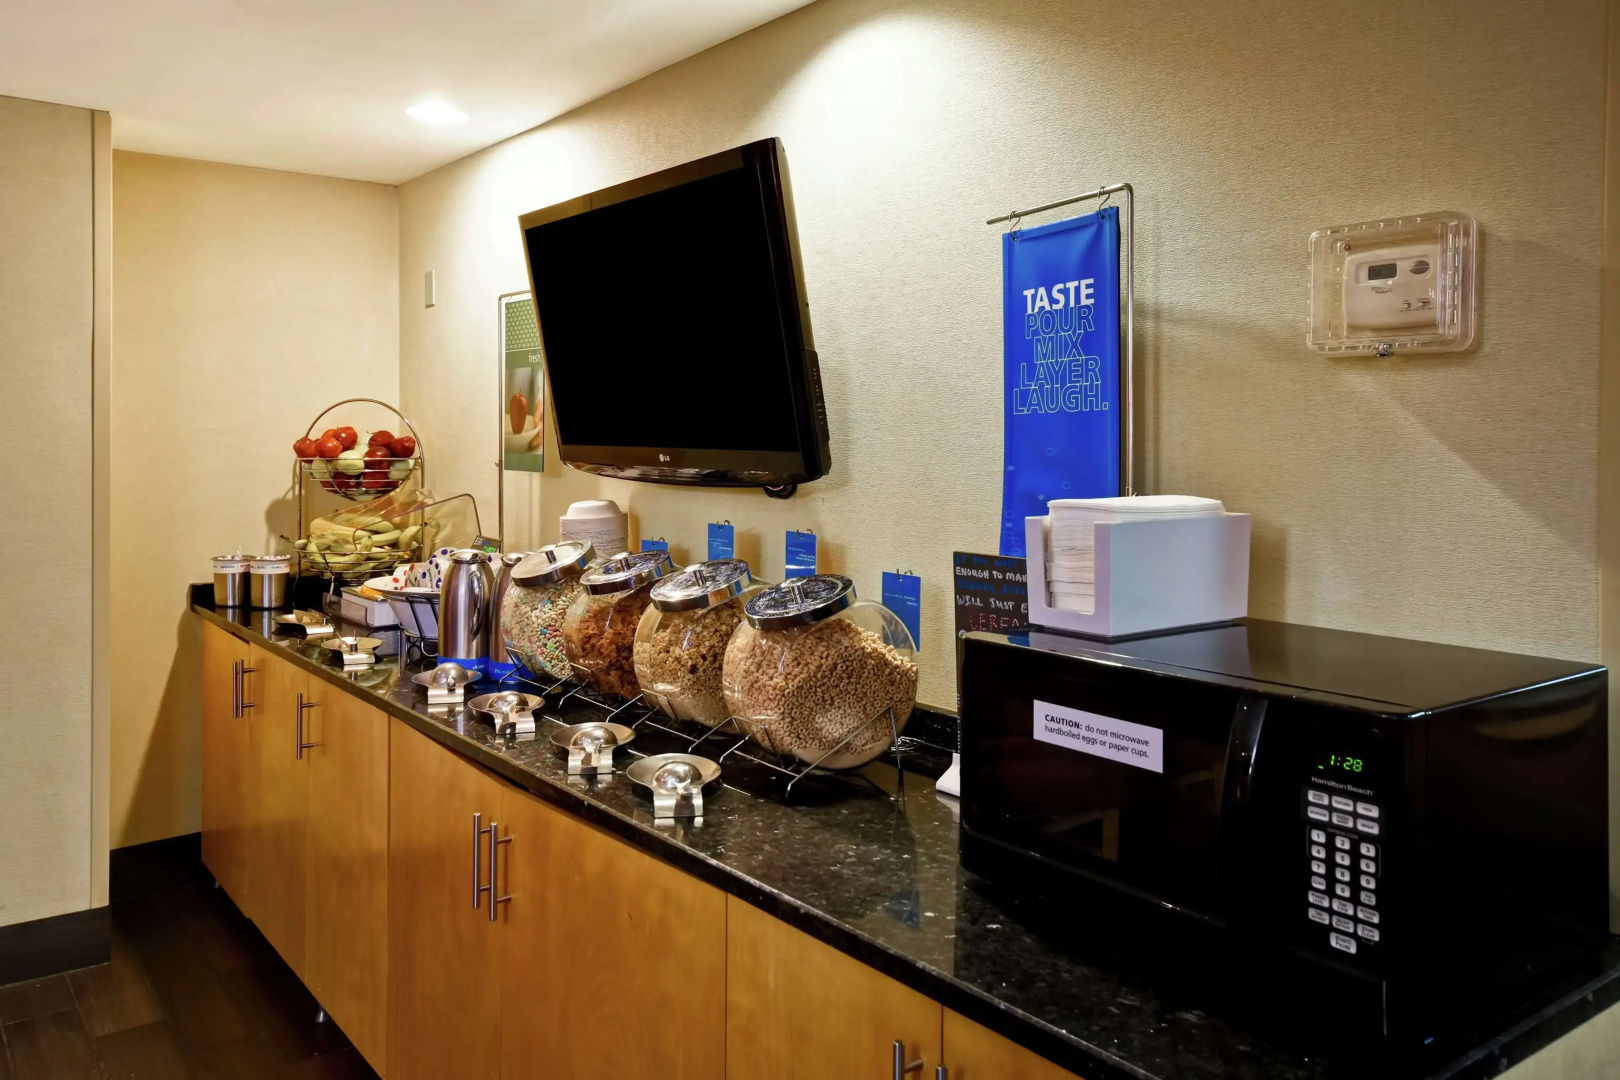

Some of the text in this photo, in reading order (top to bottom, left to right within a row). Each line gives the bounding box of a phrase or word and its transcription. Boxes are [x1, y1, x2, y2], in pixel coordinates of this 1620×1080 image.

[1023, 278, 1095, 314] TASTE
[1025, 303, 1094, 339] POUR
[1034, 330, 1085, 363] MIX
[1020, 356, 1101, 389] LAYER
[1013, 383, 1109, 414] LAUGH.
[955, 566, 1028, 582] ENOUGH TO MAK
[957, 594, 983, 606] WILL
[989, 597, 1014, 610] JUST
[1044, 714, 1149, 746] CAUTION: do not microwave
[1044, 724, 1081, 740] hardboiled
[1081, 735, 1098, 745] eggs
[1108, 741, 1129, 753] paper
[1131, 748, 1150, 758] cups.
[1330, 754, 1363, 772] 1:28
[1311, 776, 1373, 796] Hamilton Beach
